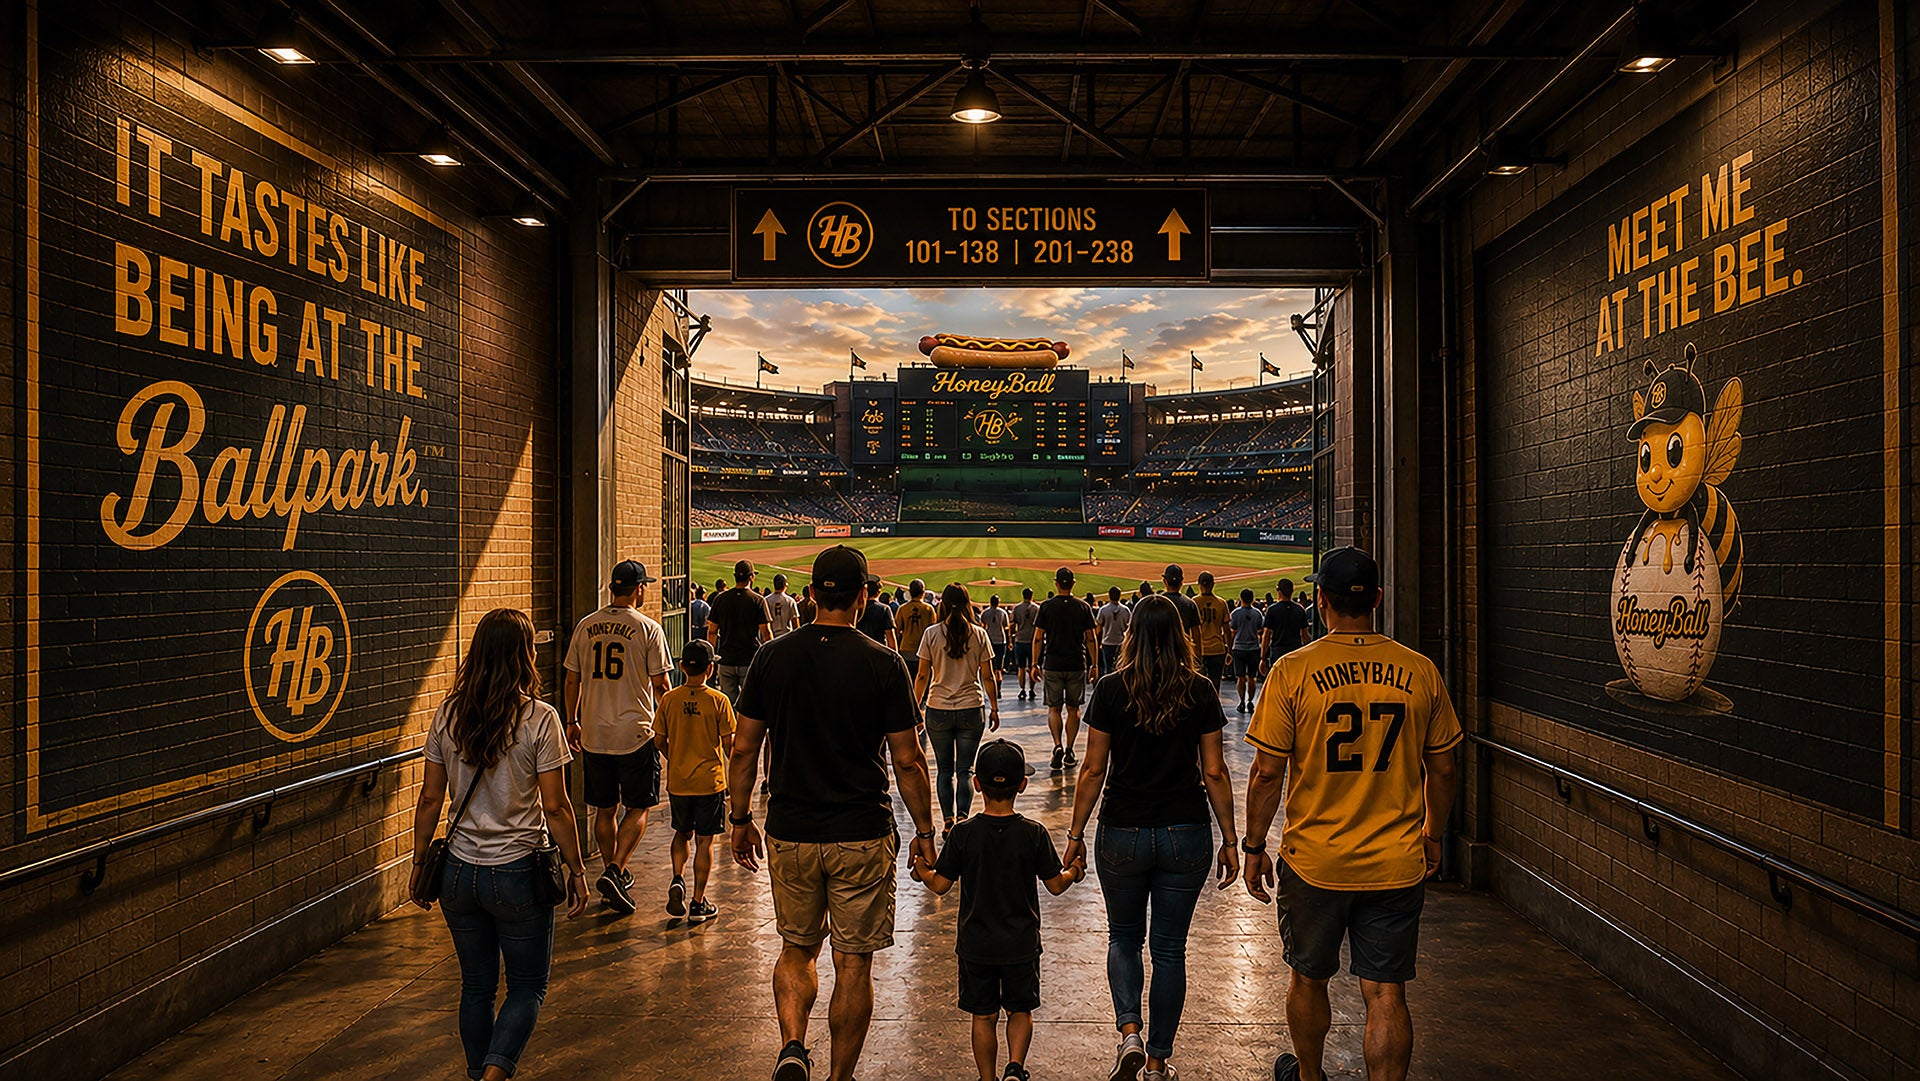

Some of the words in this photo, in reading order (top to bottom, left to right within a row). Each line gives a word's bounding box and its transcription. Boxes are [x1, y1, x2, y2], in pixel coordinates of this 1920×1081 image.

[115, 117, 173, 218] IT
[191, 149, 350, 284] TASTES
[360, 225, 427, 313] LIKE
[947, 207, 977, 231] TO
[987, 207, 1097, 231] SECTIONS
[1608, 184, 1690, 283] MEET
[1701, 149, 1756, 241] ME
[115, 240, 279, 368] BEING
[295, 300, 348, 381] AT
[1595, 286, 1629, 358] AT
[1637, 256, 1701, 340] THE
[1713, 217, 1804, 315] BEE.
[931, 371, 1057, 400] HoneyBall
[101, 379, 429, 552] Ballpark.
[1616, 595, 1711, 649] HoneyBall
[592, 640, 625, 680] 16
[1311, 660, 1415, 696] HONEYBALL
[1325, 702, 1407, 773] 27
